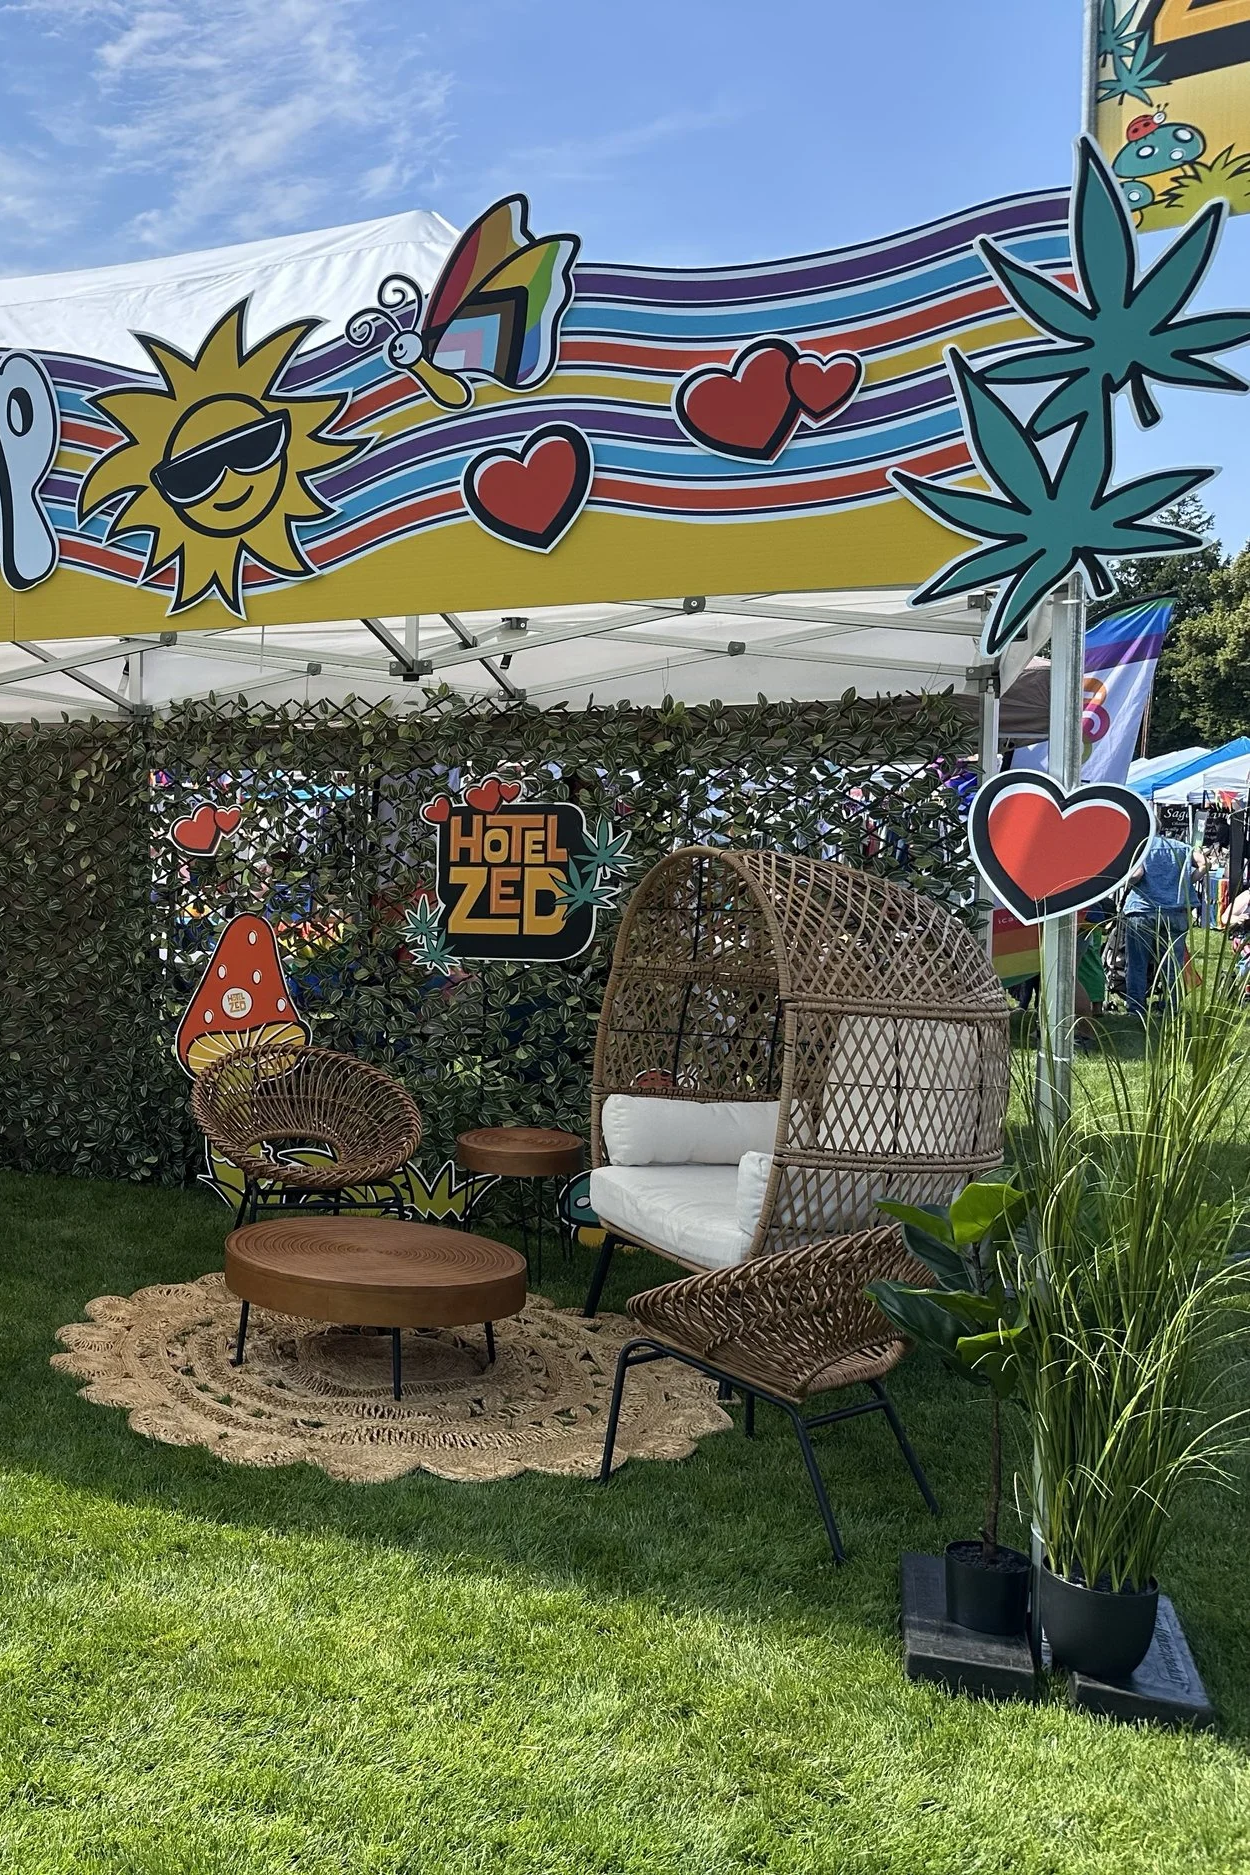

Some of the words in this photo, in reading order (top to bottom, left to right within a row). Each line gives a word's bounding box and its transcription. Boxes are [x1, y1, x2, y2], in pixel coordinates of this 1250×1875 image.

[449, 814, 568, 864] HOTEL
[448, 867, 568, 936] ZED
[227, 992, 245, 1002] HOTEL
[229, 1001, 247, 1013] ZED
